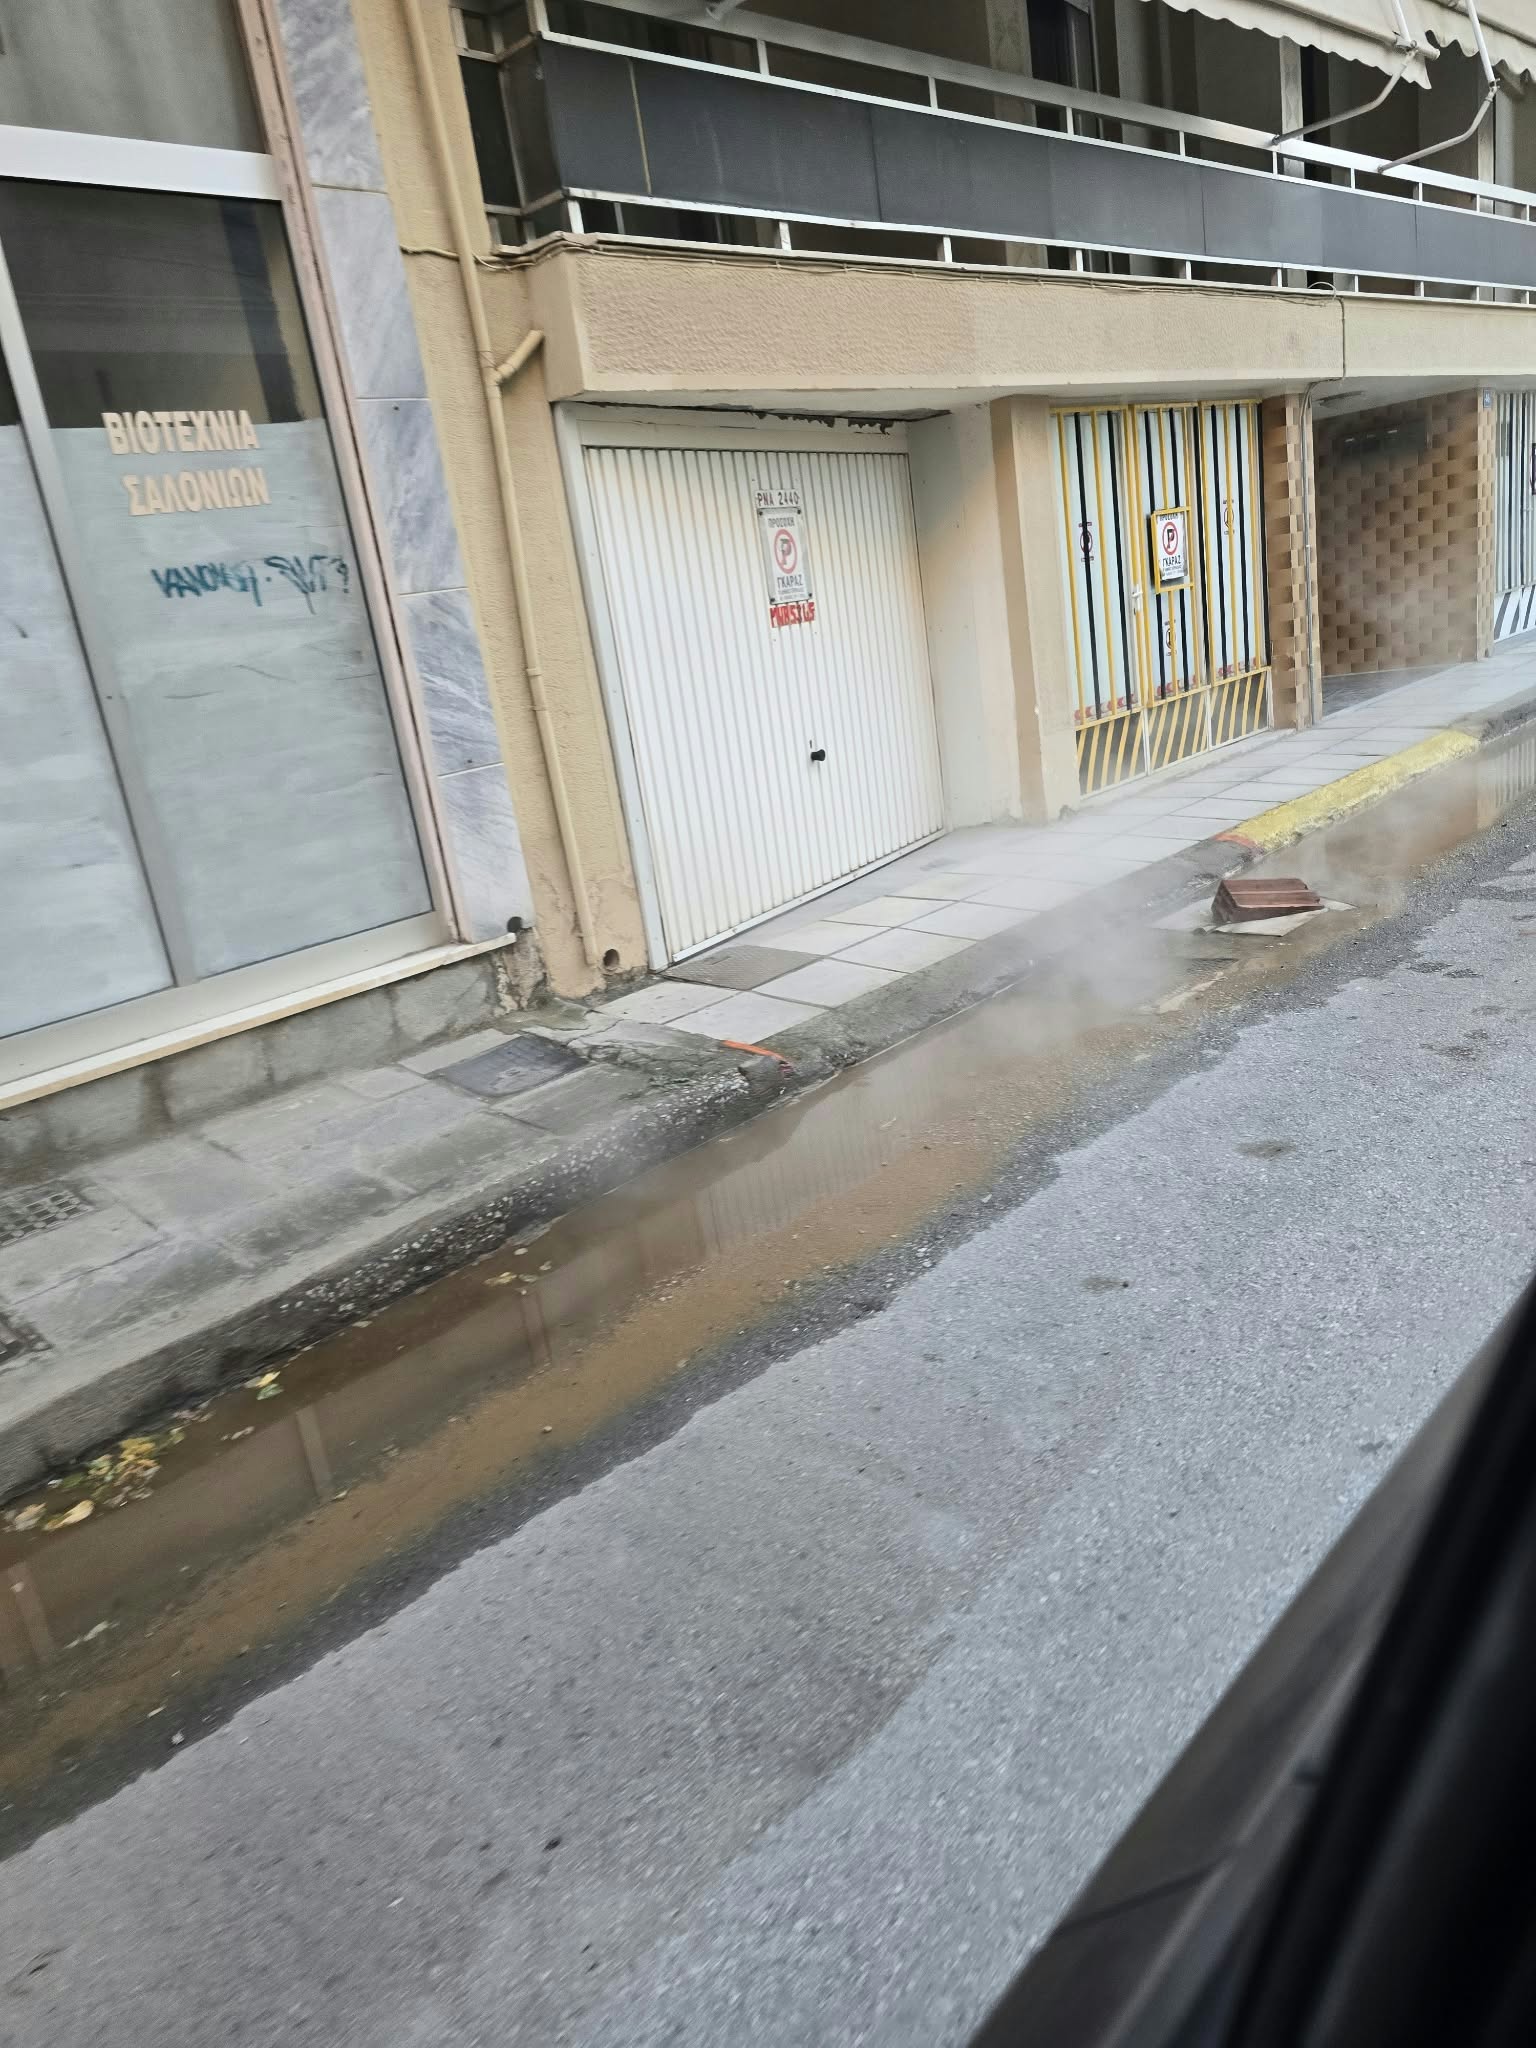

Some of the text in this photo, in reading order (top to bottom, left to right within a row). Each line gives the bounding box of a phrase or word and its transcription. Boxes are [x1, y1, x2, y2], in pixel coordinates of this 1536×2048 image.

[101, 410, 260, 455] ΒΙΟΤΕΧΝΙΑ
[122, 467, 272, 516] ΣΑΛΟΝΙΩΝ
[1163, 555, 1182, 567] ΓΚΑΡΑΖ
[777, 575, 803, 588] ΓΚΑΡΑΖ
